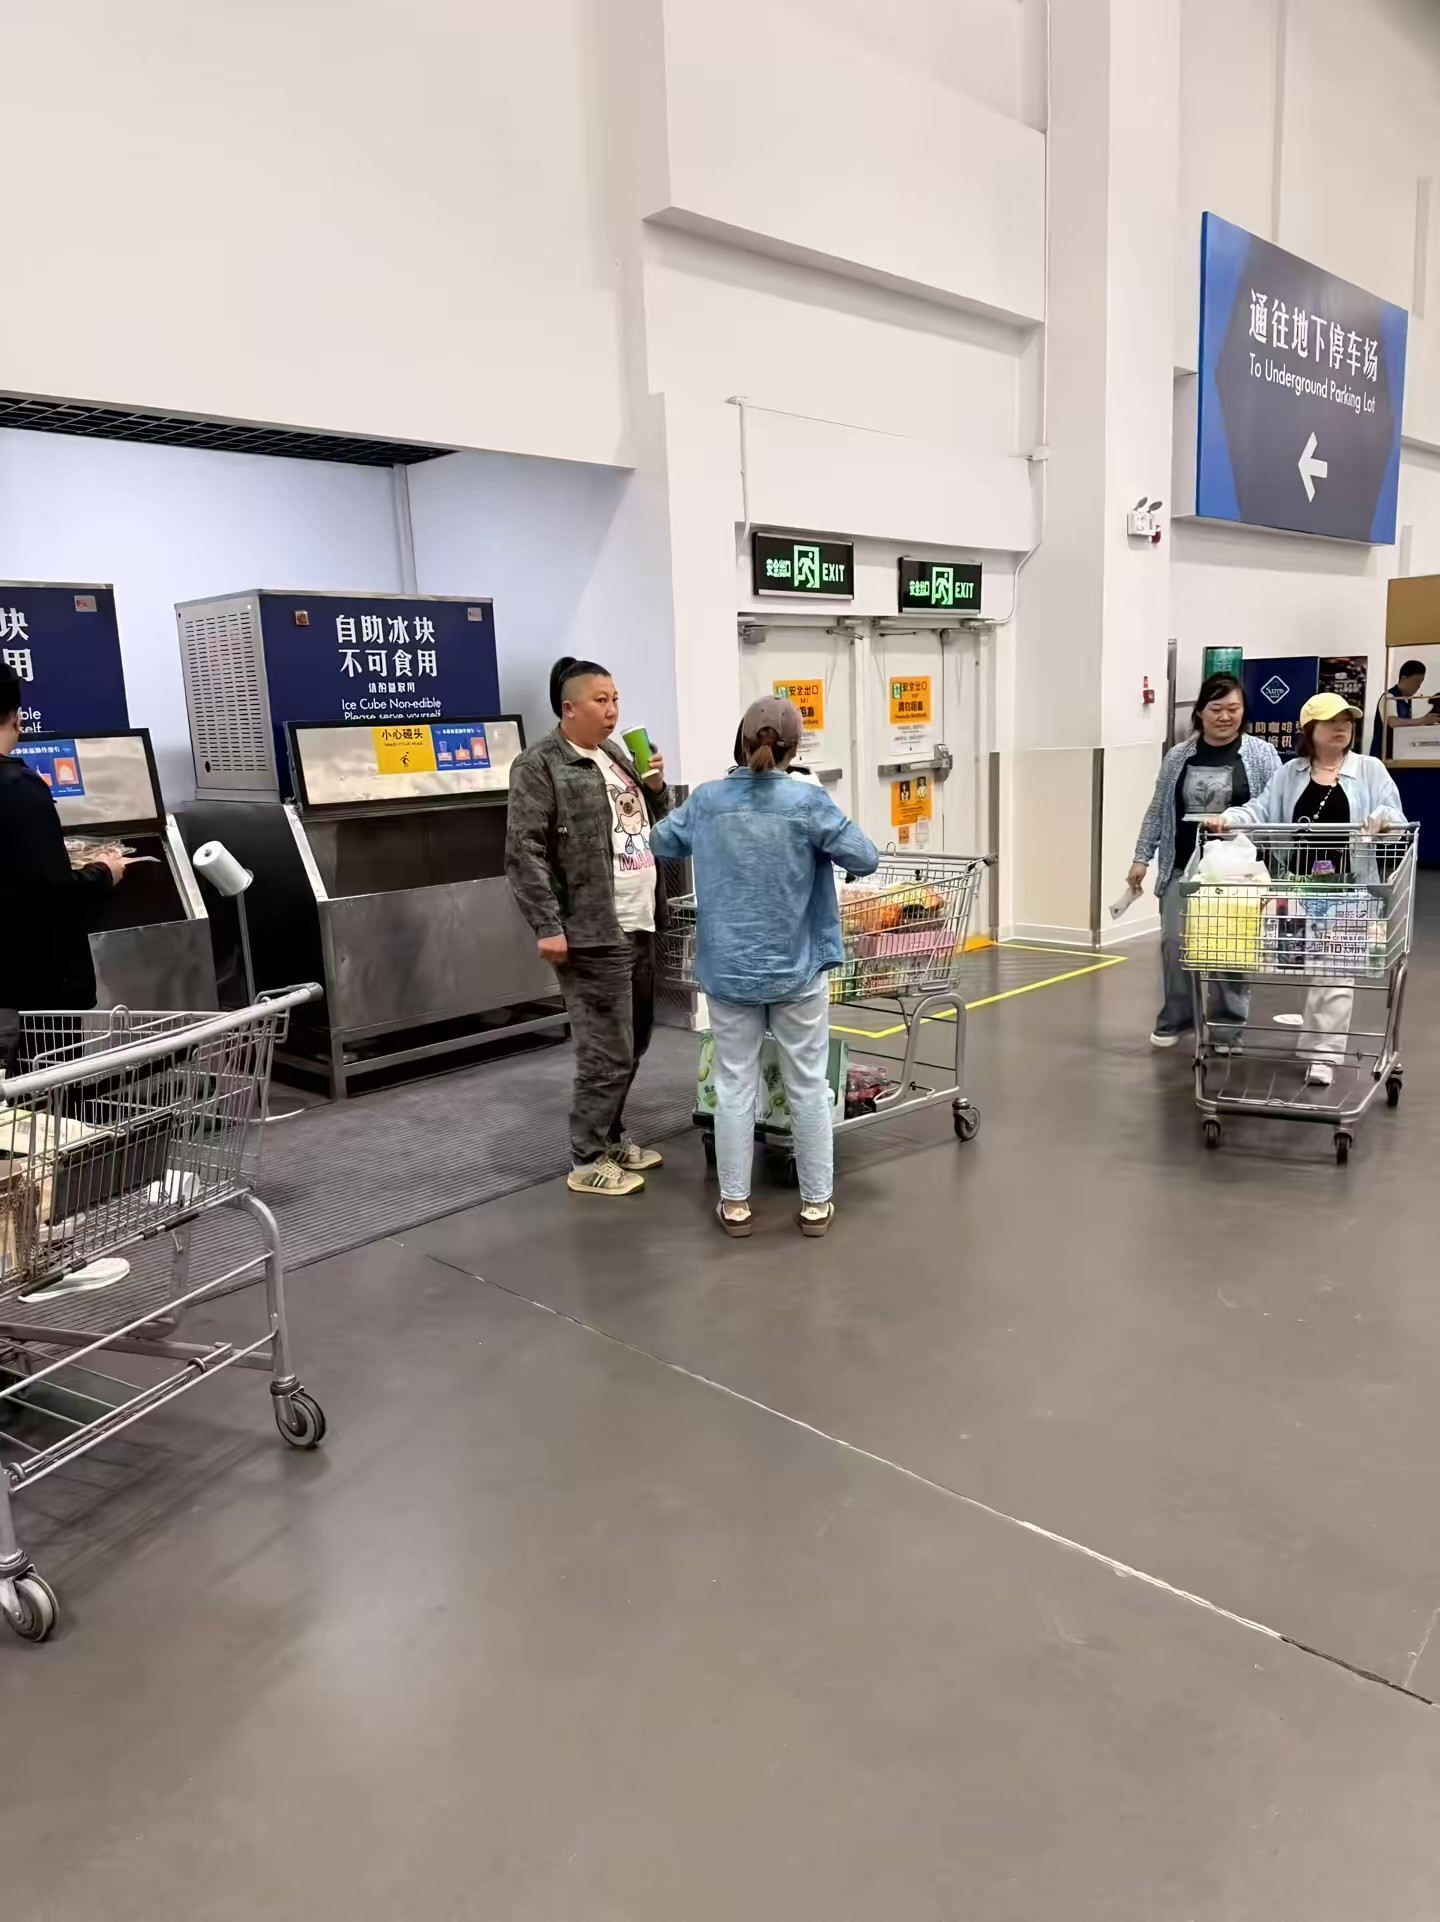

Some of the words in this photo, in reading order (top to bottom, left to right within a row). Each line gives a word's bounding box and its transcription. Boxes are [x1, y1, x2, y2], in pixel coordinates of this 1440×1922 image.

[1249, 289, 1378, 382] 通往地下停车场
[1249, 353, 1262, 378] To
[1265, 359, 1328, 398] Underground
[1329, 380, 1361, 414] Parking
[1363, 392, 1376, 413] Lot
[822, 563, 845, 582] EXIT
[955, 582, 974, 598] EXIT
[335, 614, 436, 644] 自助冰块
[338, 649, 438, 678] 不可食用
[789, 685, 819, 696] 安全出口
[341, 699, 357, 710] Ice
[359, 698, 387, 710] Cube
[389, 696, 442, 710] Non-edible
